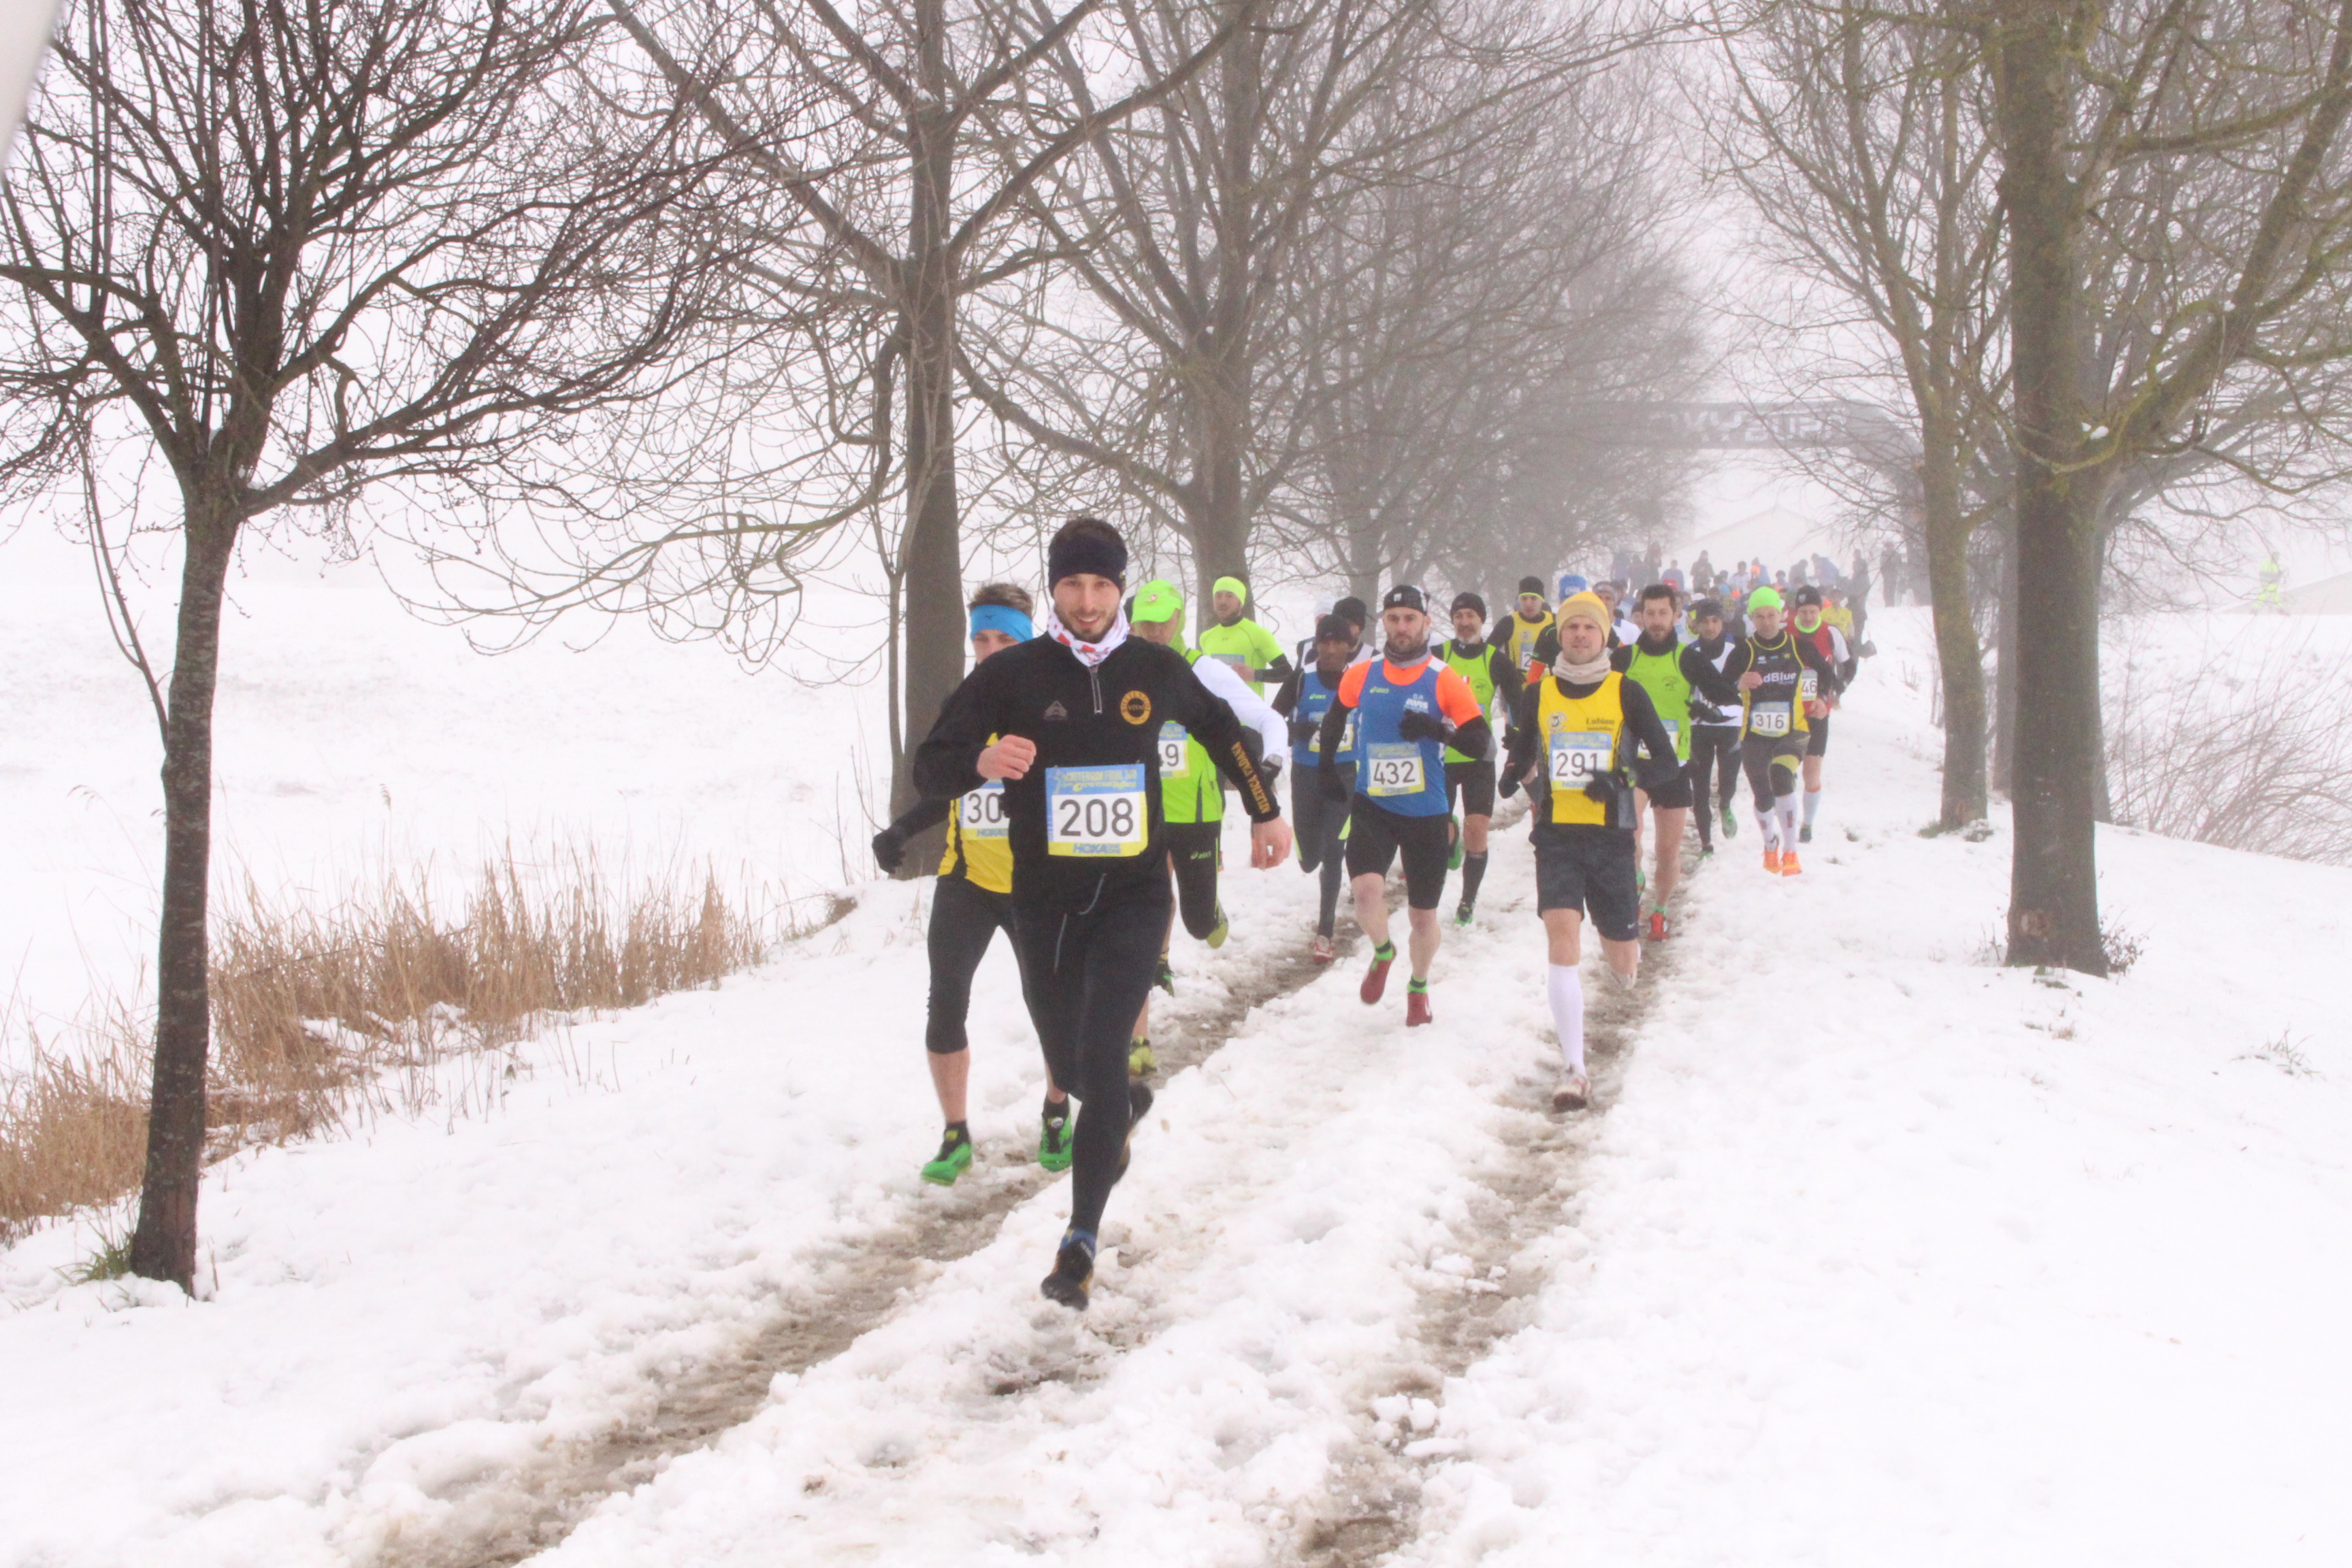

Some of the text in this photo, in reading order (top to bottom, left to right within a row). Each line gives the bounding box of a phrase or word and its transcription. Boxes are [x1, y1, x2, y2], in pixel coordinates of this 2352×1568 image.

[1763, 672, 1797, 683] dBlue
[1754, 714, 1784, 729] 316
[1373, 761, 1416, 785] 432
[1556, 752, 1597, 777] 291
[967, 793, 1007, 823] 30
[1059, 798, 1134, 837] 208
